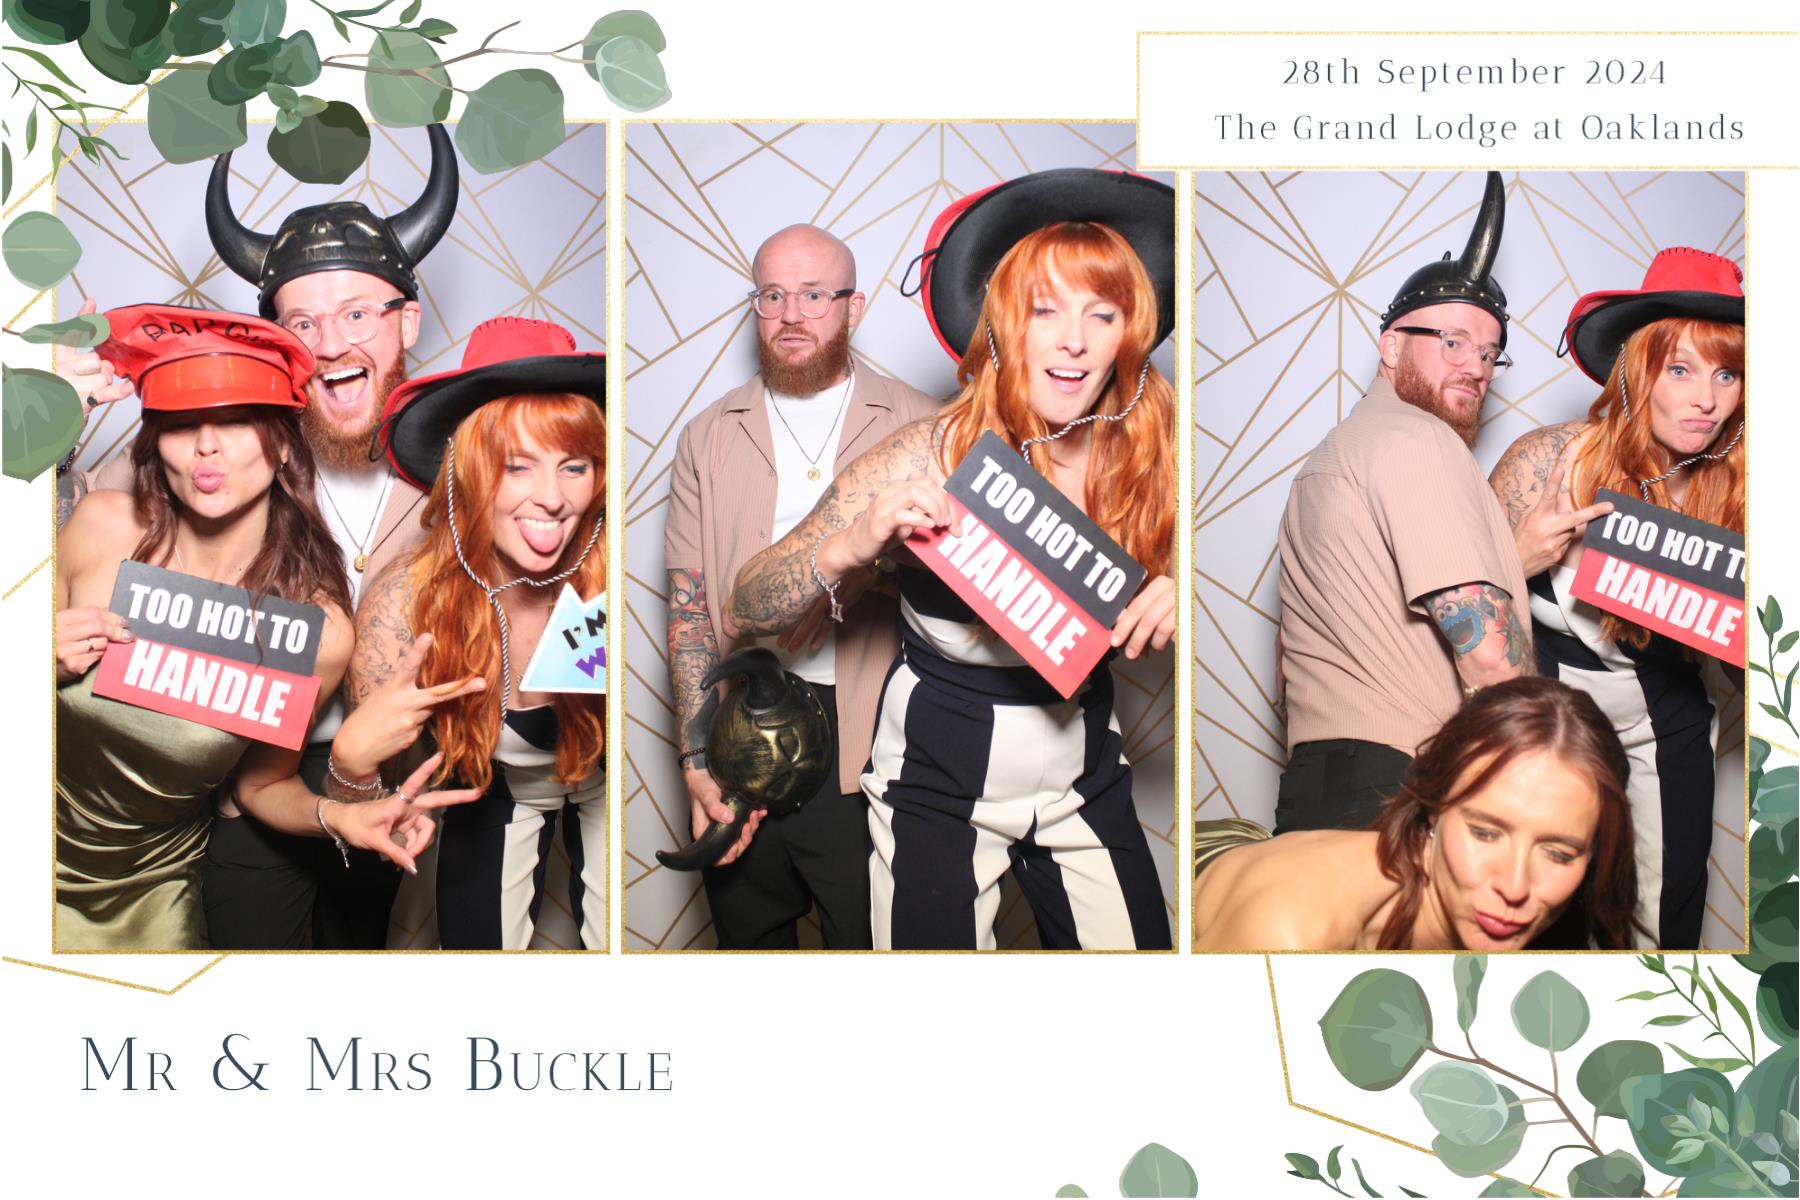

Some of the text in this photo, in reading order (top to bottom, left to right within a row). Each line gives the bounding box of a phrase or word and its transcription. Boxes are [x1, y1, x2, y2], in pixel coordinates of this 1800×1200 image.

[970, 456, 1127, 602] TOO HOT TO
[1602, 511, 1659, 552] TOO
[1659, 527, 1724, 572] HOT
[128, 582, 309, 654] TOO HOT TO
[937, 513, 1088, 666] HANDLE
[1594, 555, 1743, 647] HANDLE
[123, 638, 292, 728] HANDLE
